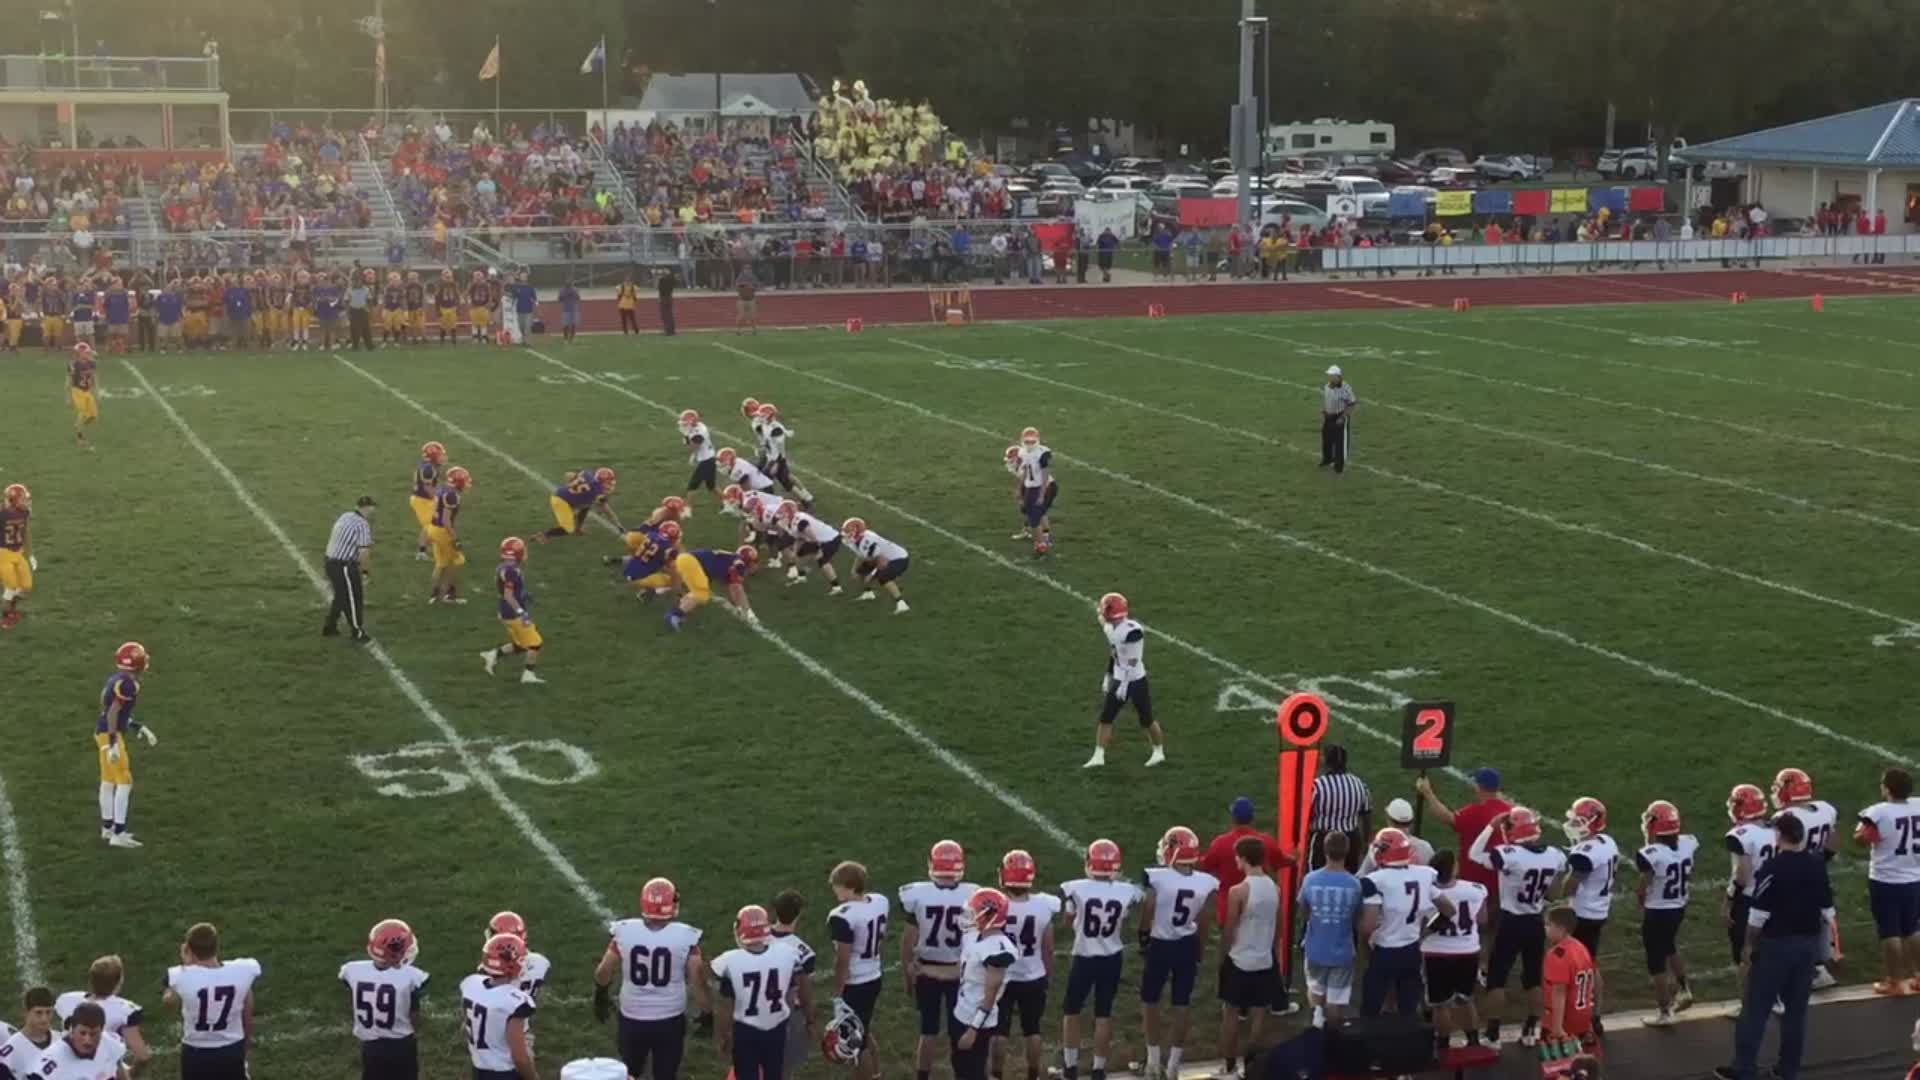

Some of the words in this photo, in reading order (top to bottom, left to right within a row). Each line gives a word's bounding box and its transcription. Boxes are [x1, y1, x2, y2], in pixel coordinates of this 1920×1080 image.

[1413, 708, 1446, 754] 2
[351, 737, 599, 799] 50
[1083, 898, 1123, 939] 63
[1171, 889, 1195, 927] 5
[1404, 880, 1420, 925] 7
[629, 945, 672, 988] 60
[194, 985, 236, 1032] 17
[355, 981, 396, 1030] 59
[743, 968, 783, 1017] 74
